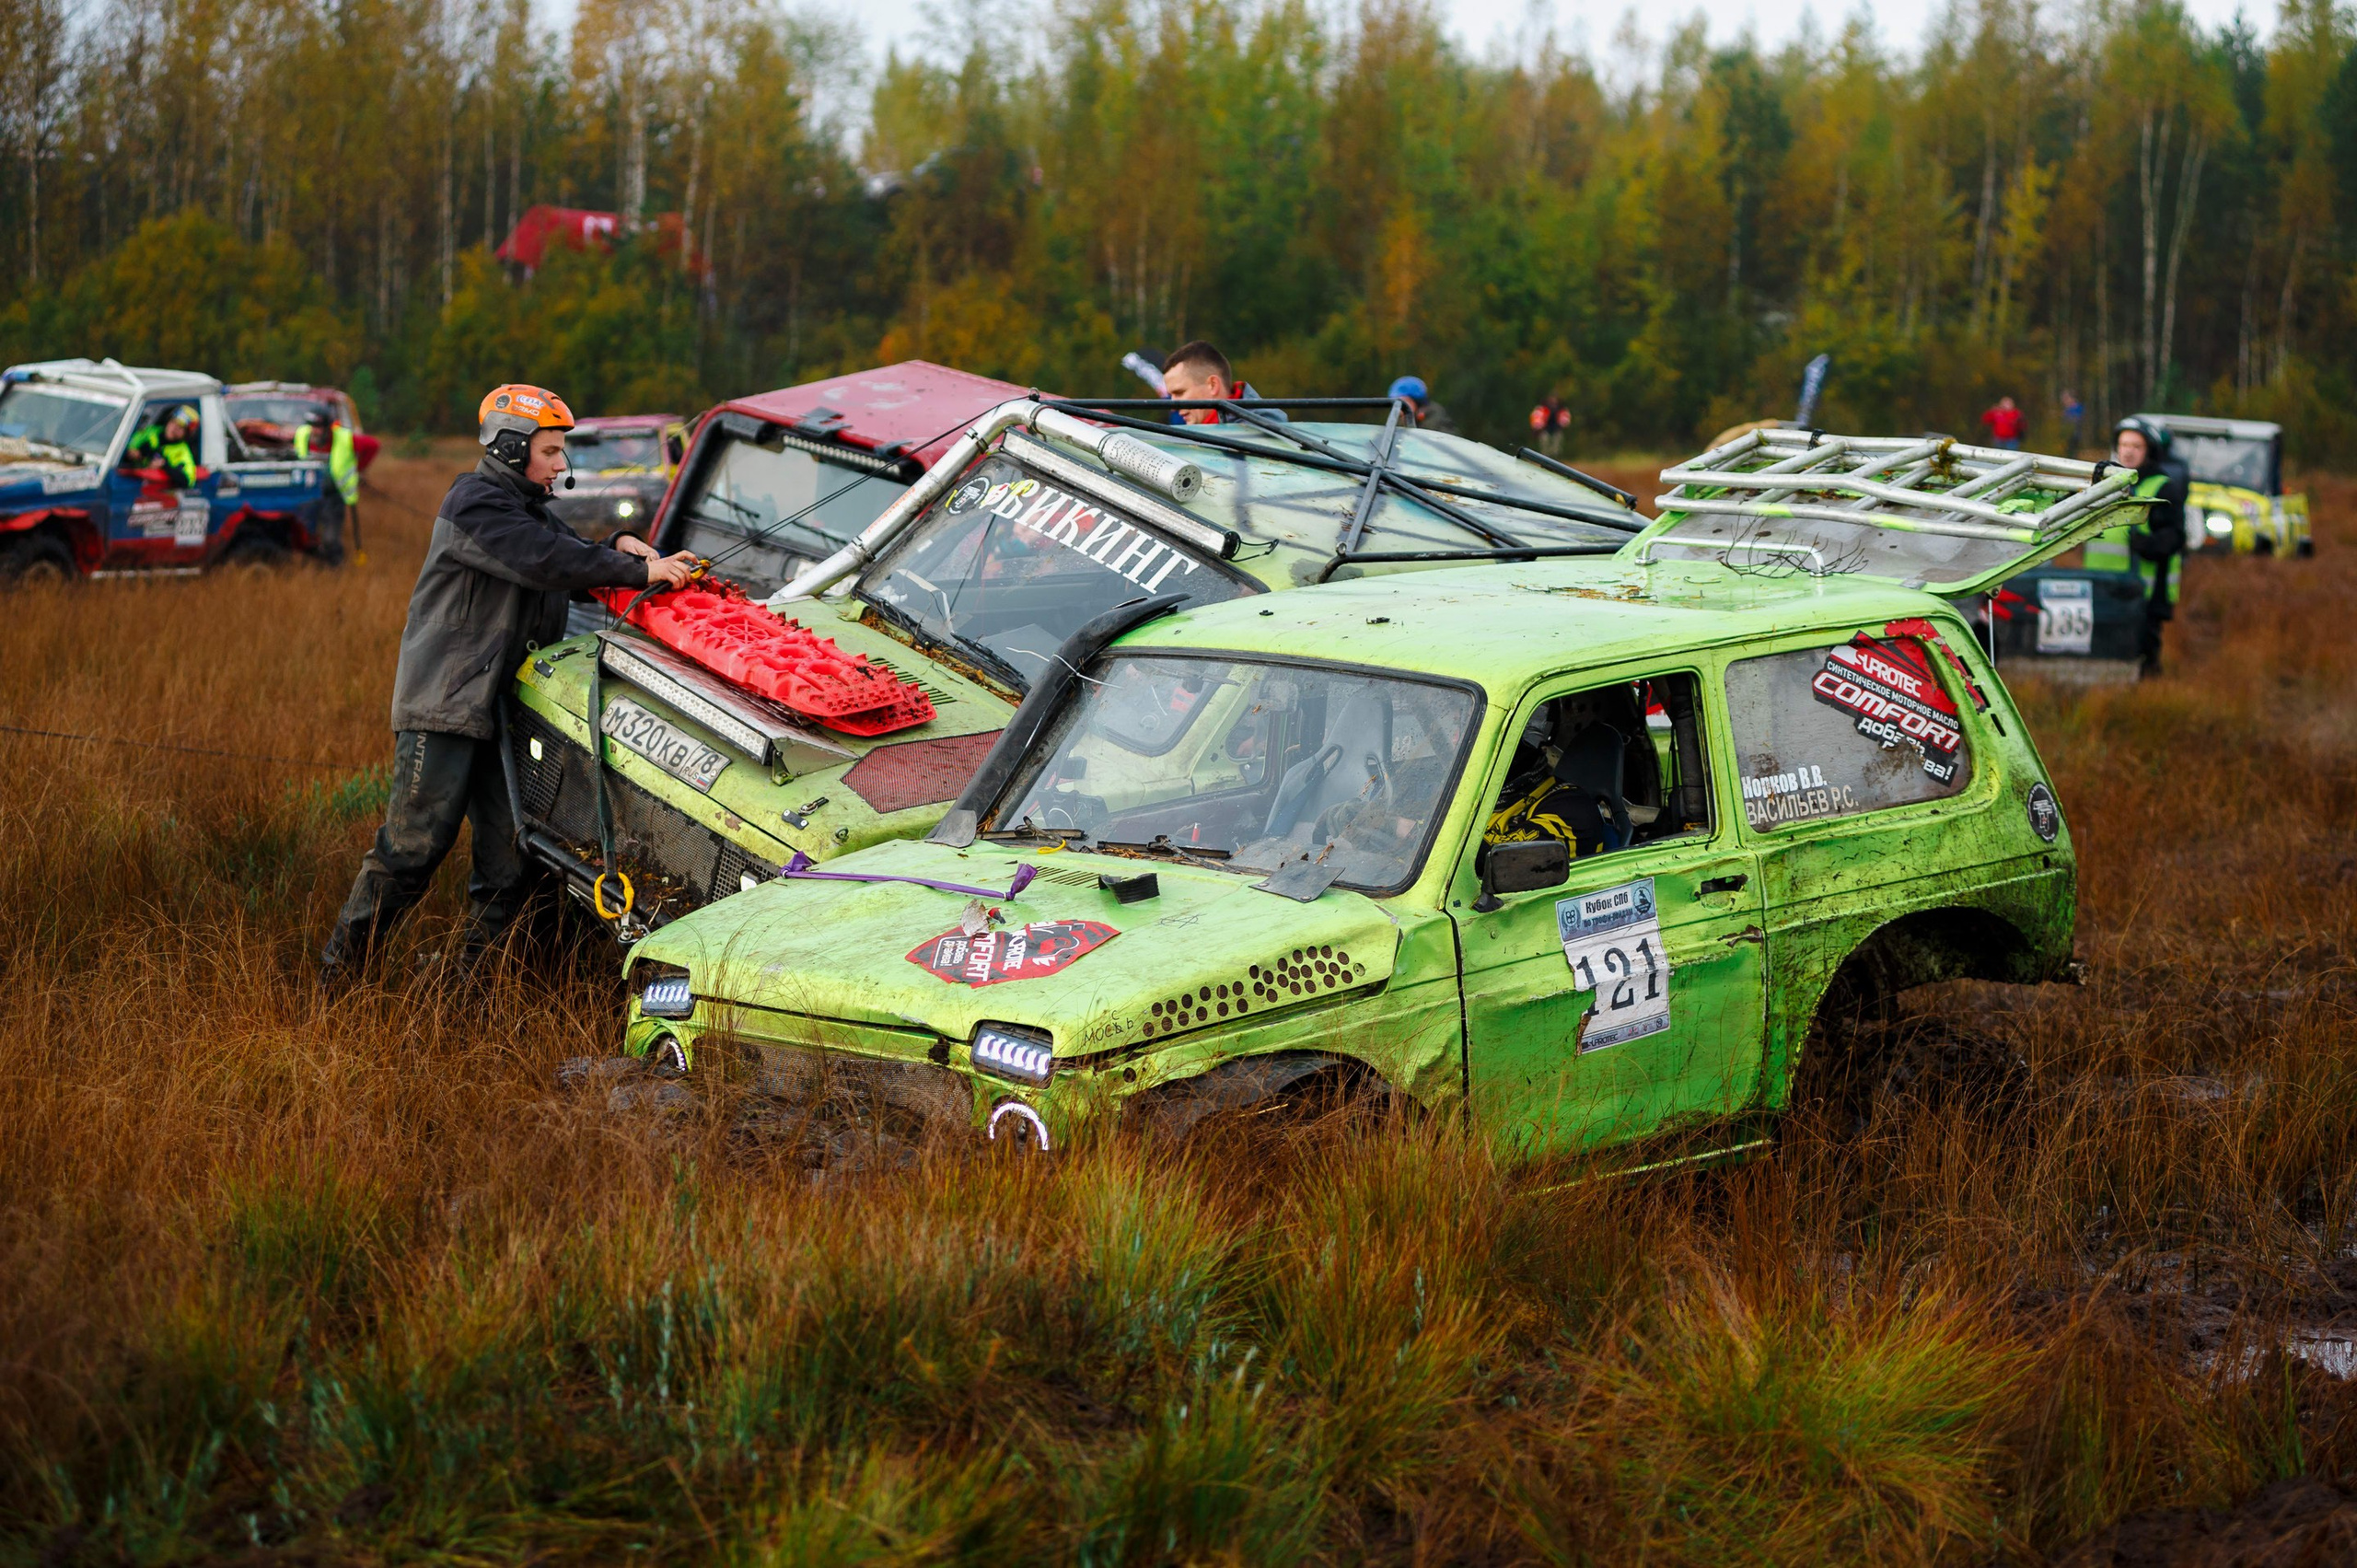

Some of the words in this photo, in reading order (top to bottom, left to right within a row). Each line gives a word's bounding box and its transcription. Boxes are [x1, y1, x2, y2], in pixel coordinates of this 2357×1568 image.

[990, 479, 1200, 595] ВИКИНГ
[1813, 671, 1961, 750] COMFORT
[1827, 660, 1891, 698] СИНТЕТИЧЕСКОЕ
[1891, 691, 1932, 716] МОТОРНОЕ
[1932, 711, 1959, 730] МАСЛО
[411, 732, 427, 799] NTRAIL
[681, 766, 700, 781] RUS
[1797, 765, 1828, 790] В.В.
[1745, 789, 1830, 826] ВАСИЛЬЕВ
[1830, 784, 1860, 810] Р.С.
[1585, 898, 1613, 914] Кубок
[1613, 891, 1629, 907] СПб
[966, 931, 996, 982] MFORT
[1575, 937, 1661, 1016] 121
